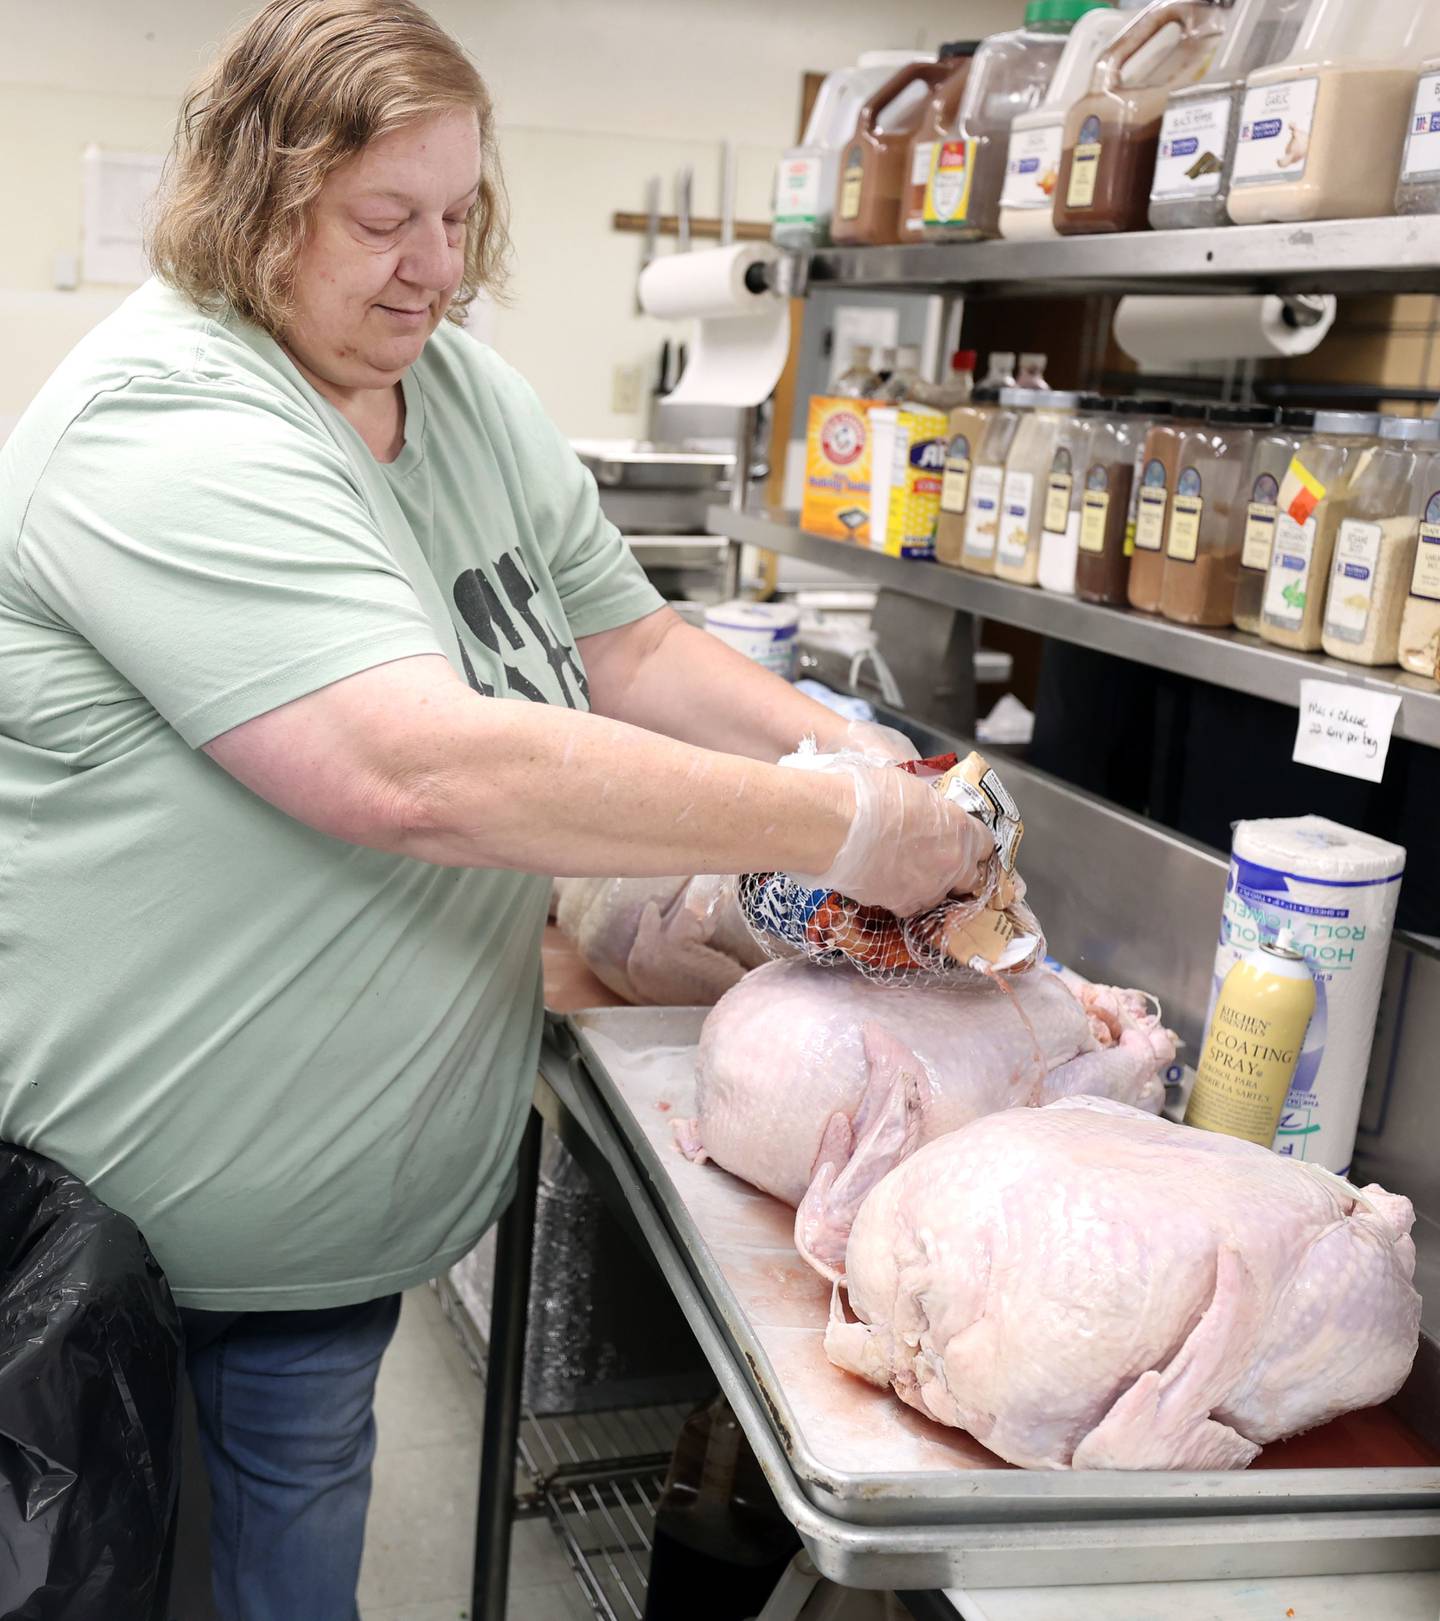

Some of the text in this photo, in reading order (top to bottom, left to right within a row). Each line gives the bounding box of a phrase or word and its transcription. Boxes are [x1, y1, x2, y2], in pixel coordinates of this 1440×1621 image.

[1306, 922, 1367, 941] ROLL
[1208, 1047, 1259, 1076] SPRAY
[1216, 1030, 1294, 1064] COATING
